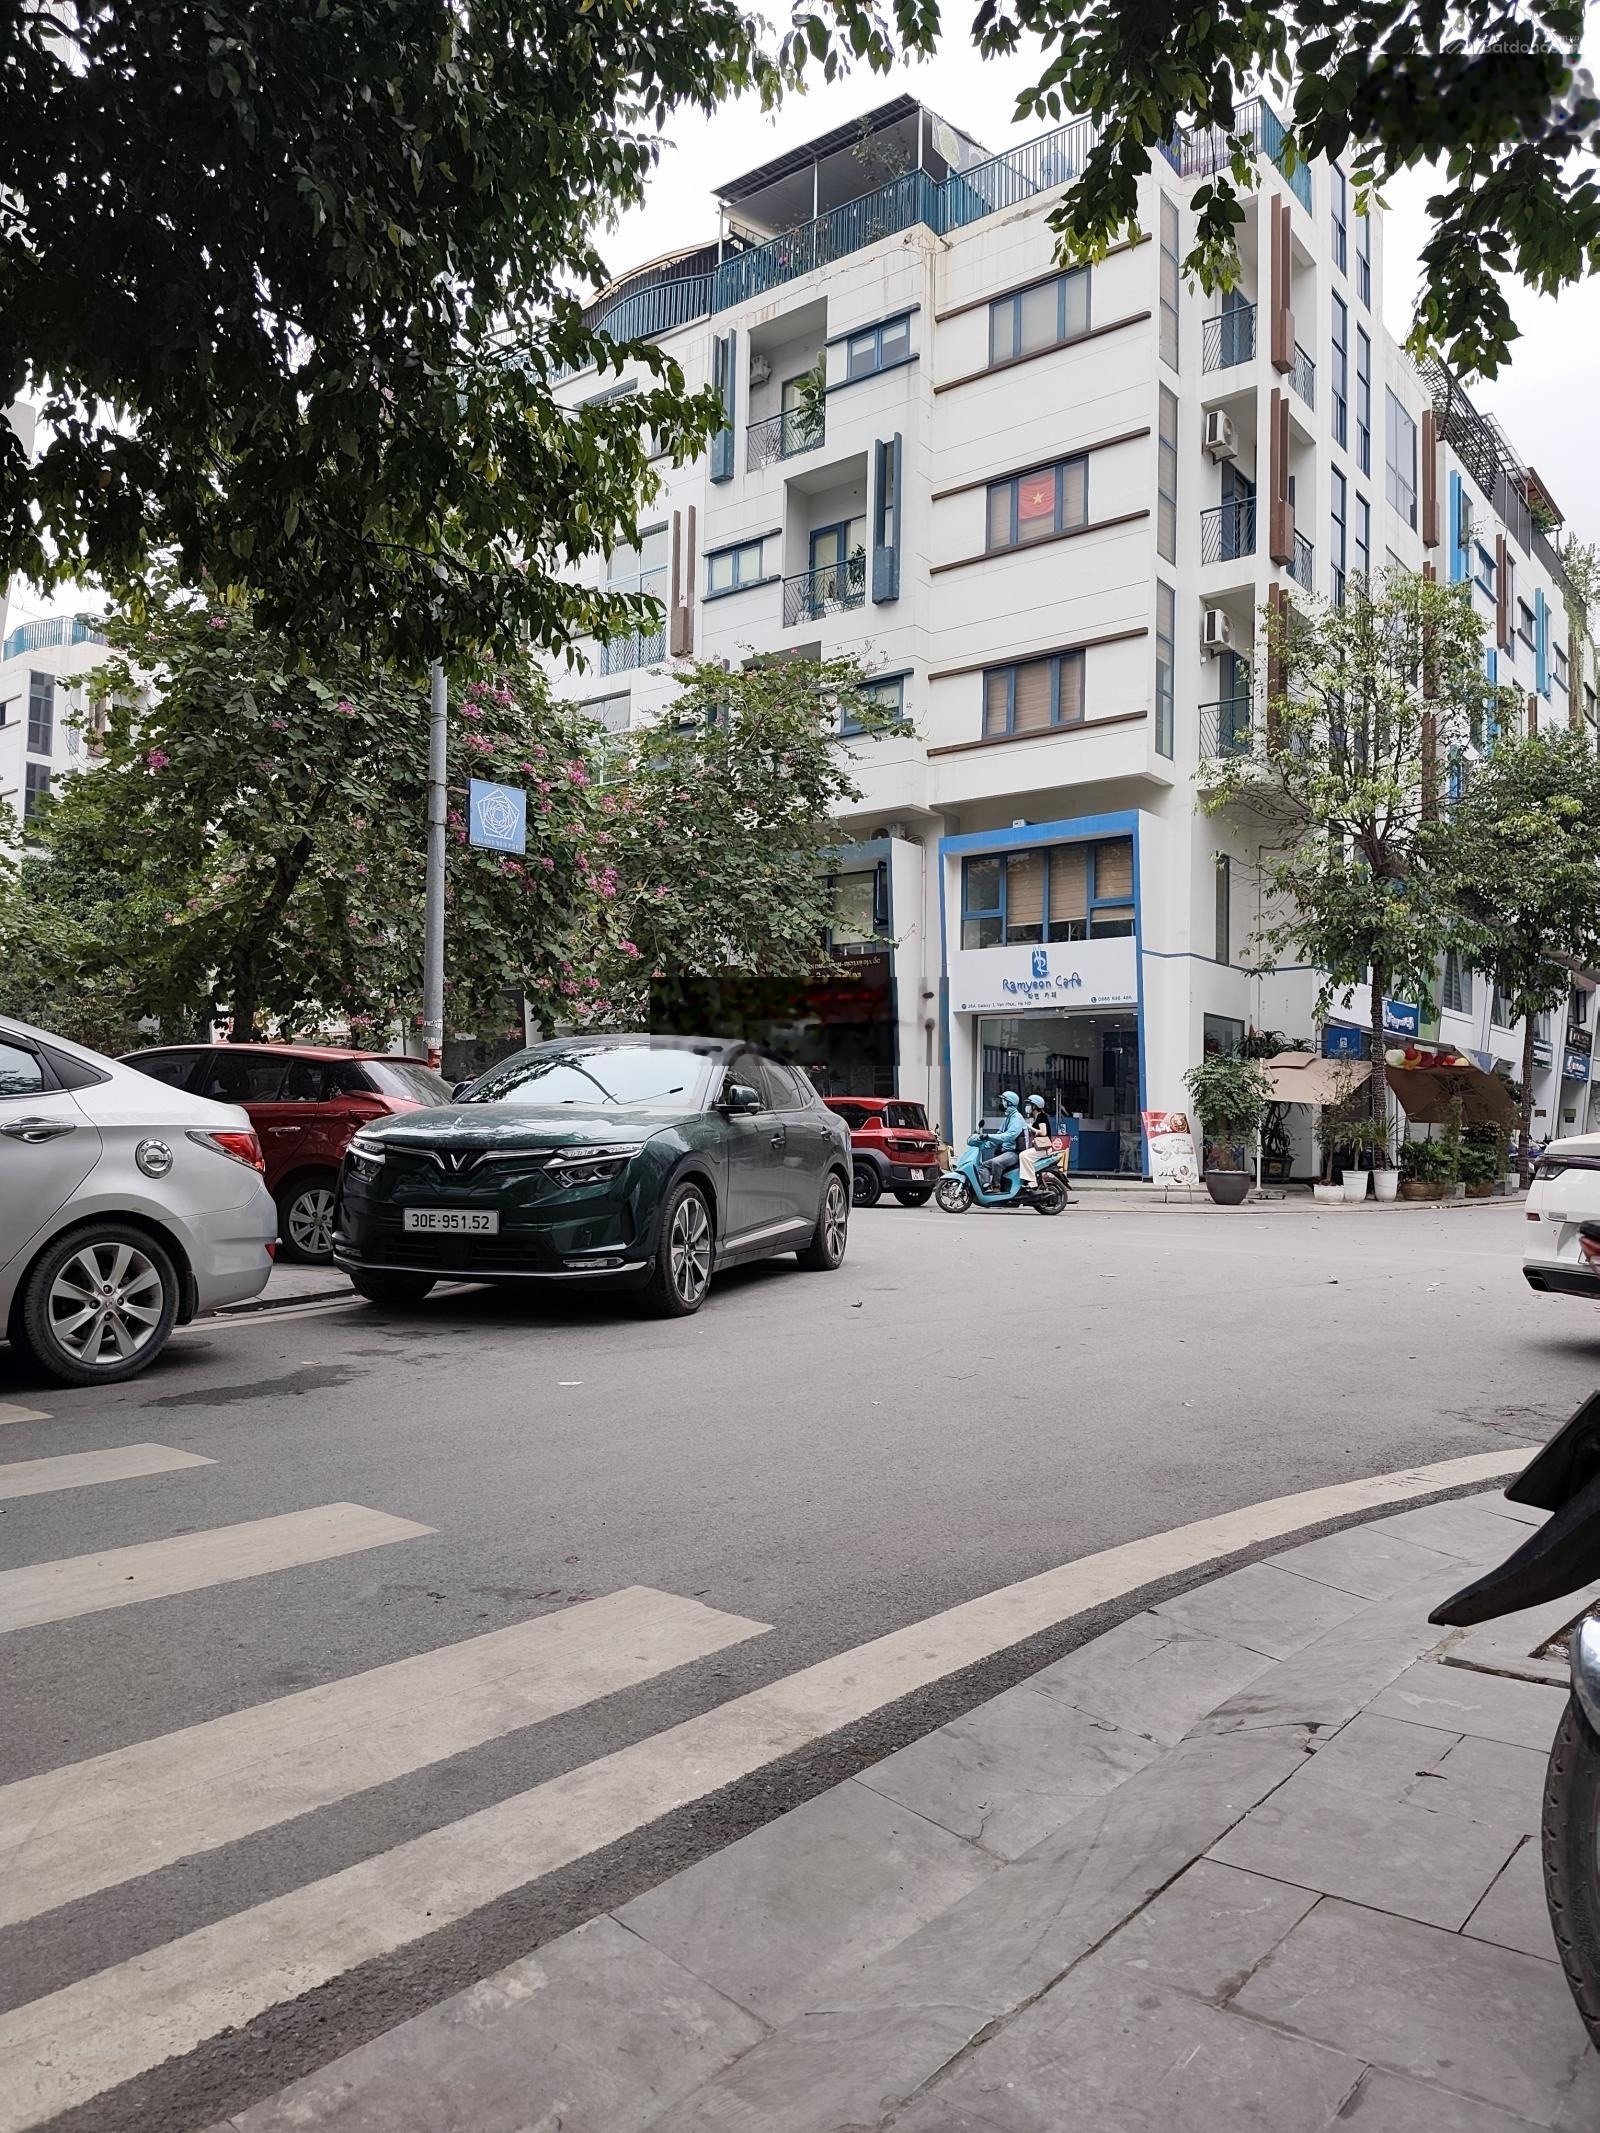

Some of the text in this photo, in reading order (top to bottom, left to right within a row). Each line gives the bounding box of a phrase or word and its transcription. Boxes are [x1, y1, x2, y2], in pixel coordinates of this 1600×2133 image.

[1002, 972, 1082, 993] Ramyeon Cafe
[411, 1213, 490, 1230] 30E-951.52
